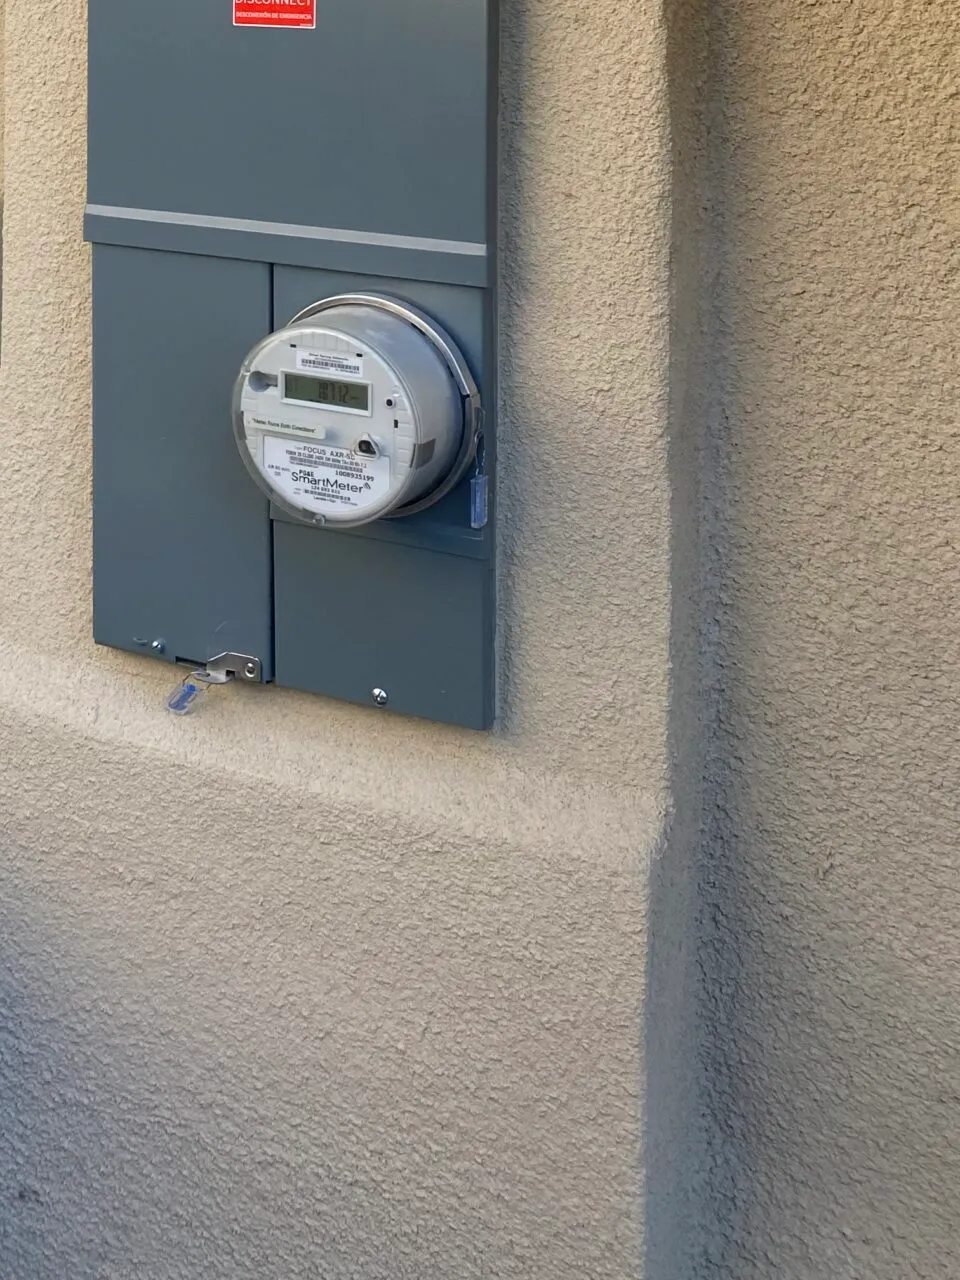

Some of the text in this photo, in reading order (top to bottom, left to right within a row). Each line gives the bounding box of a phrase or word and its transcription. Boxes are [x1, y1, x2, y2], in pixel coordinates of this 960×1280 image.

[303, 446, 326, 456] FOCUS
[299, 469, 314, 478] PG&E
[291, 472, 363, 493] SmartMeter
